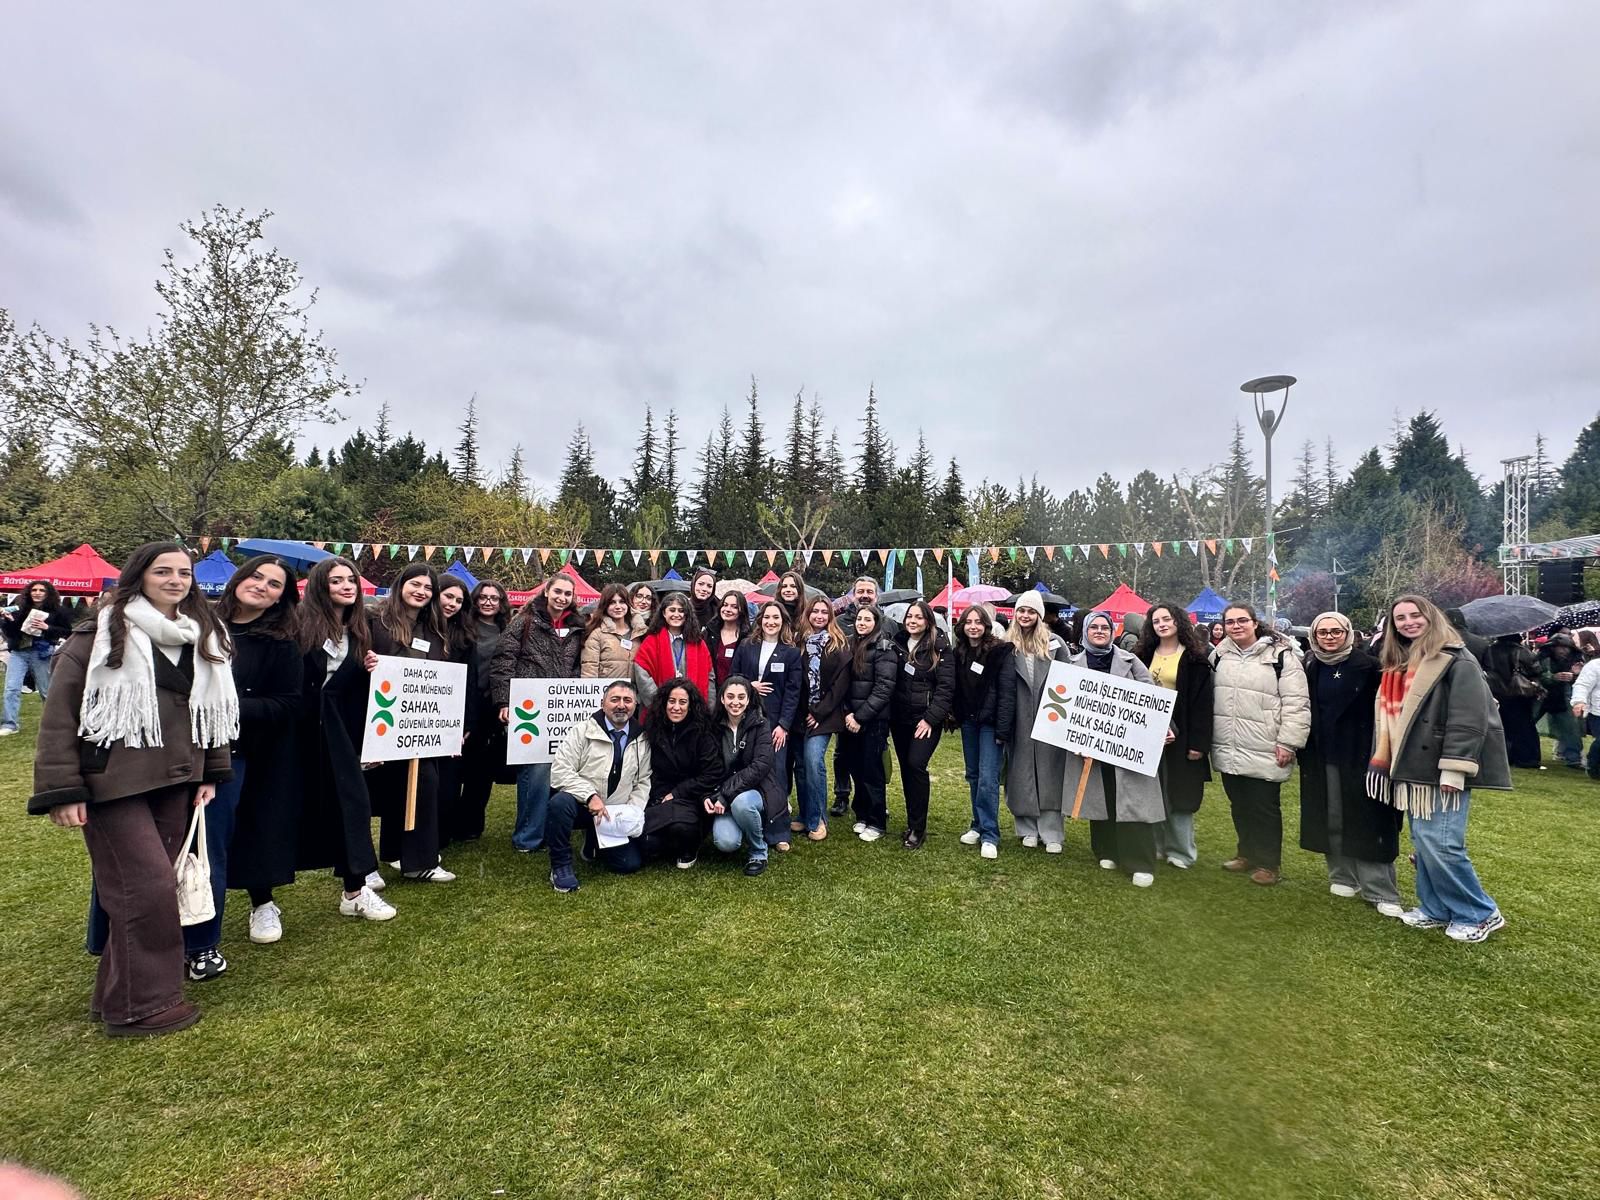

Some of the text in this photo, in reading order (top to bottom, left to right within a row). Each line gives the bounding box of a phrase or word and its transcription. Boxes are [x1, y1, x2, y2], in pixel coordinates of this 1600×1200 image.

[404, 668, 438, 681] DAHA ÇOK
[403, 684, 453, 695] GIDA MÜHENDİSİ
[548, 684, 600, 695] GÜVENİLİR
[1080, 679, 1171, 714] GIDA İŞLETMELERİNDE
[401, 701, 440, 715] SAHAYA,
[548, 698, 564, 709] BİR
[567, 699, 597, 709] HAYAL
[547, 713, 571, 722] GIDA
[1074, 695, 1148, 728] MÜHENDİS YOKSA,
[399, 718, 460, 729] GÜVENİLİR GIDALAR
[1070, 712, 1126, 739] HALK SAĞLIĞI
[397, 734, 441, 748] SOFRAYA
[1066, 729, 1145, 765] TEHDİT ALTINDADIR.
